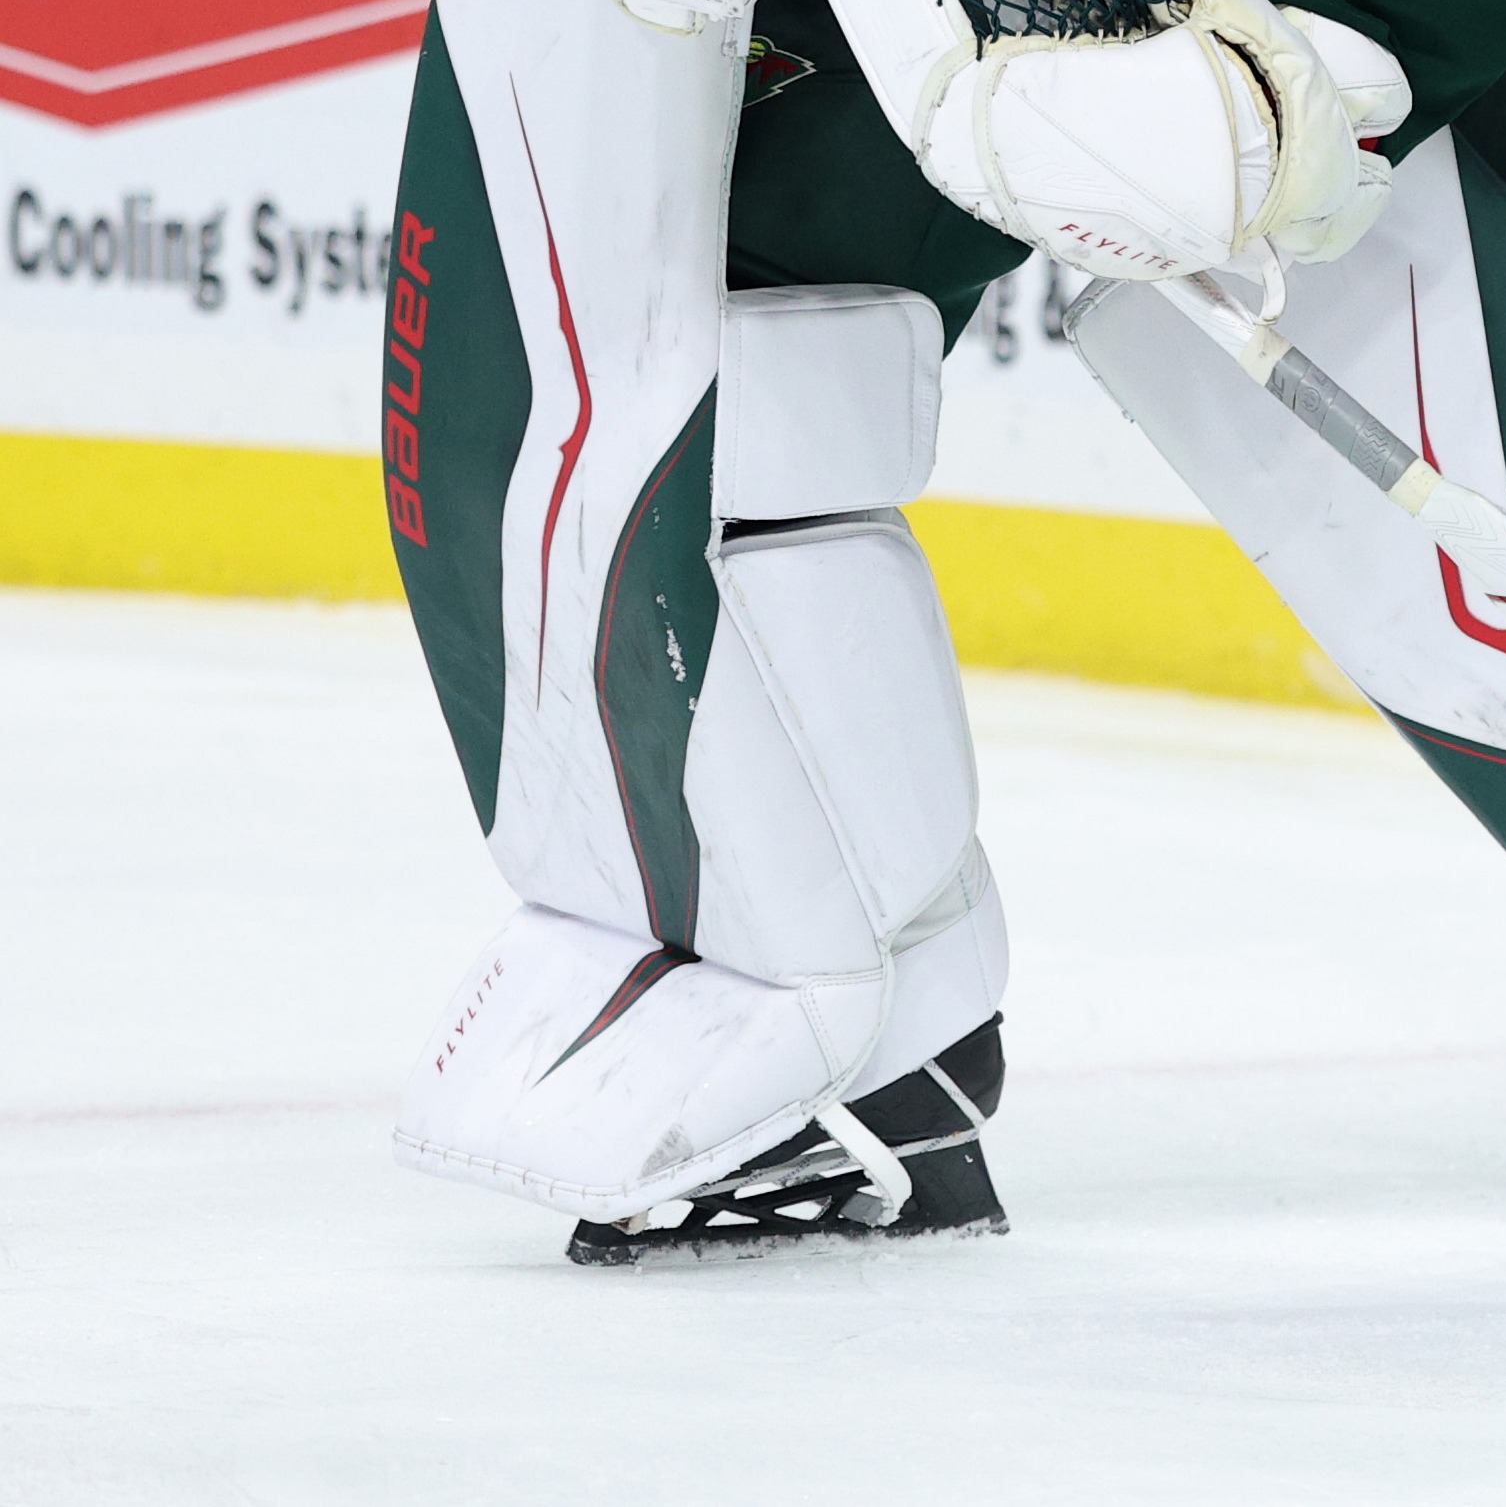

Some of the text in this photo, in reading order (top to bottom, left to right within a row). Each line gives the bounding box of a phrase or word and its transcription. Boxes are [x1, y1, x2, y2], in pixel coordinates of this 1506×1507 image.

[12, 190, 227, 310] Cooling
[1059, 223, 1179, 271] FLYLITE
[386, 210, 435, 547] BAUER
[436, 958, 504, 1075] FLYLITE
